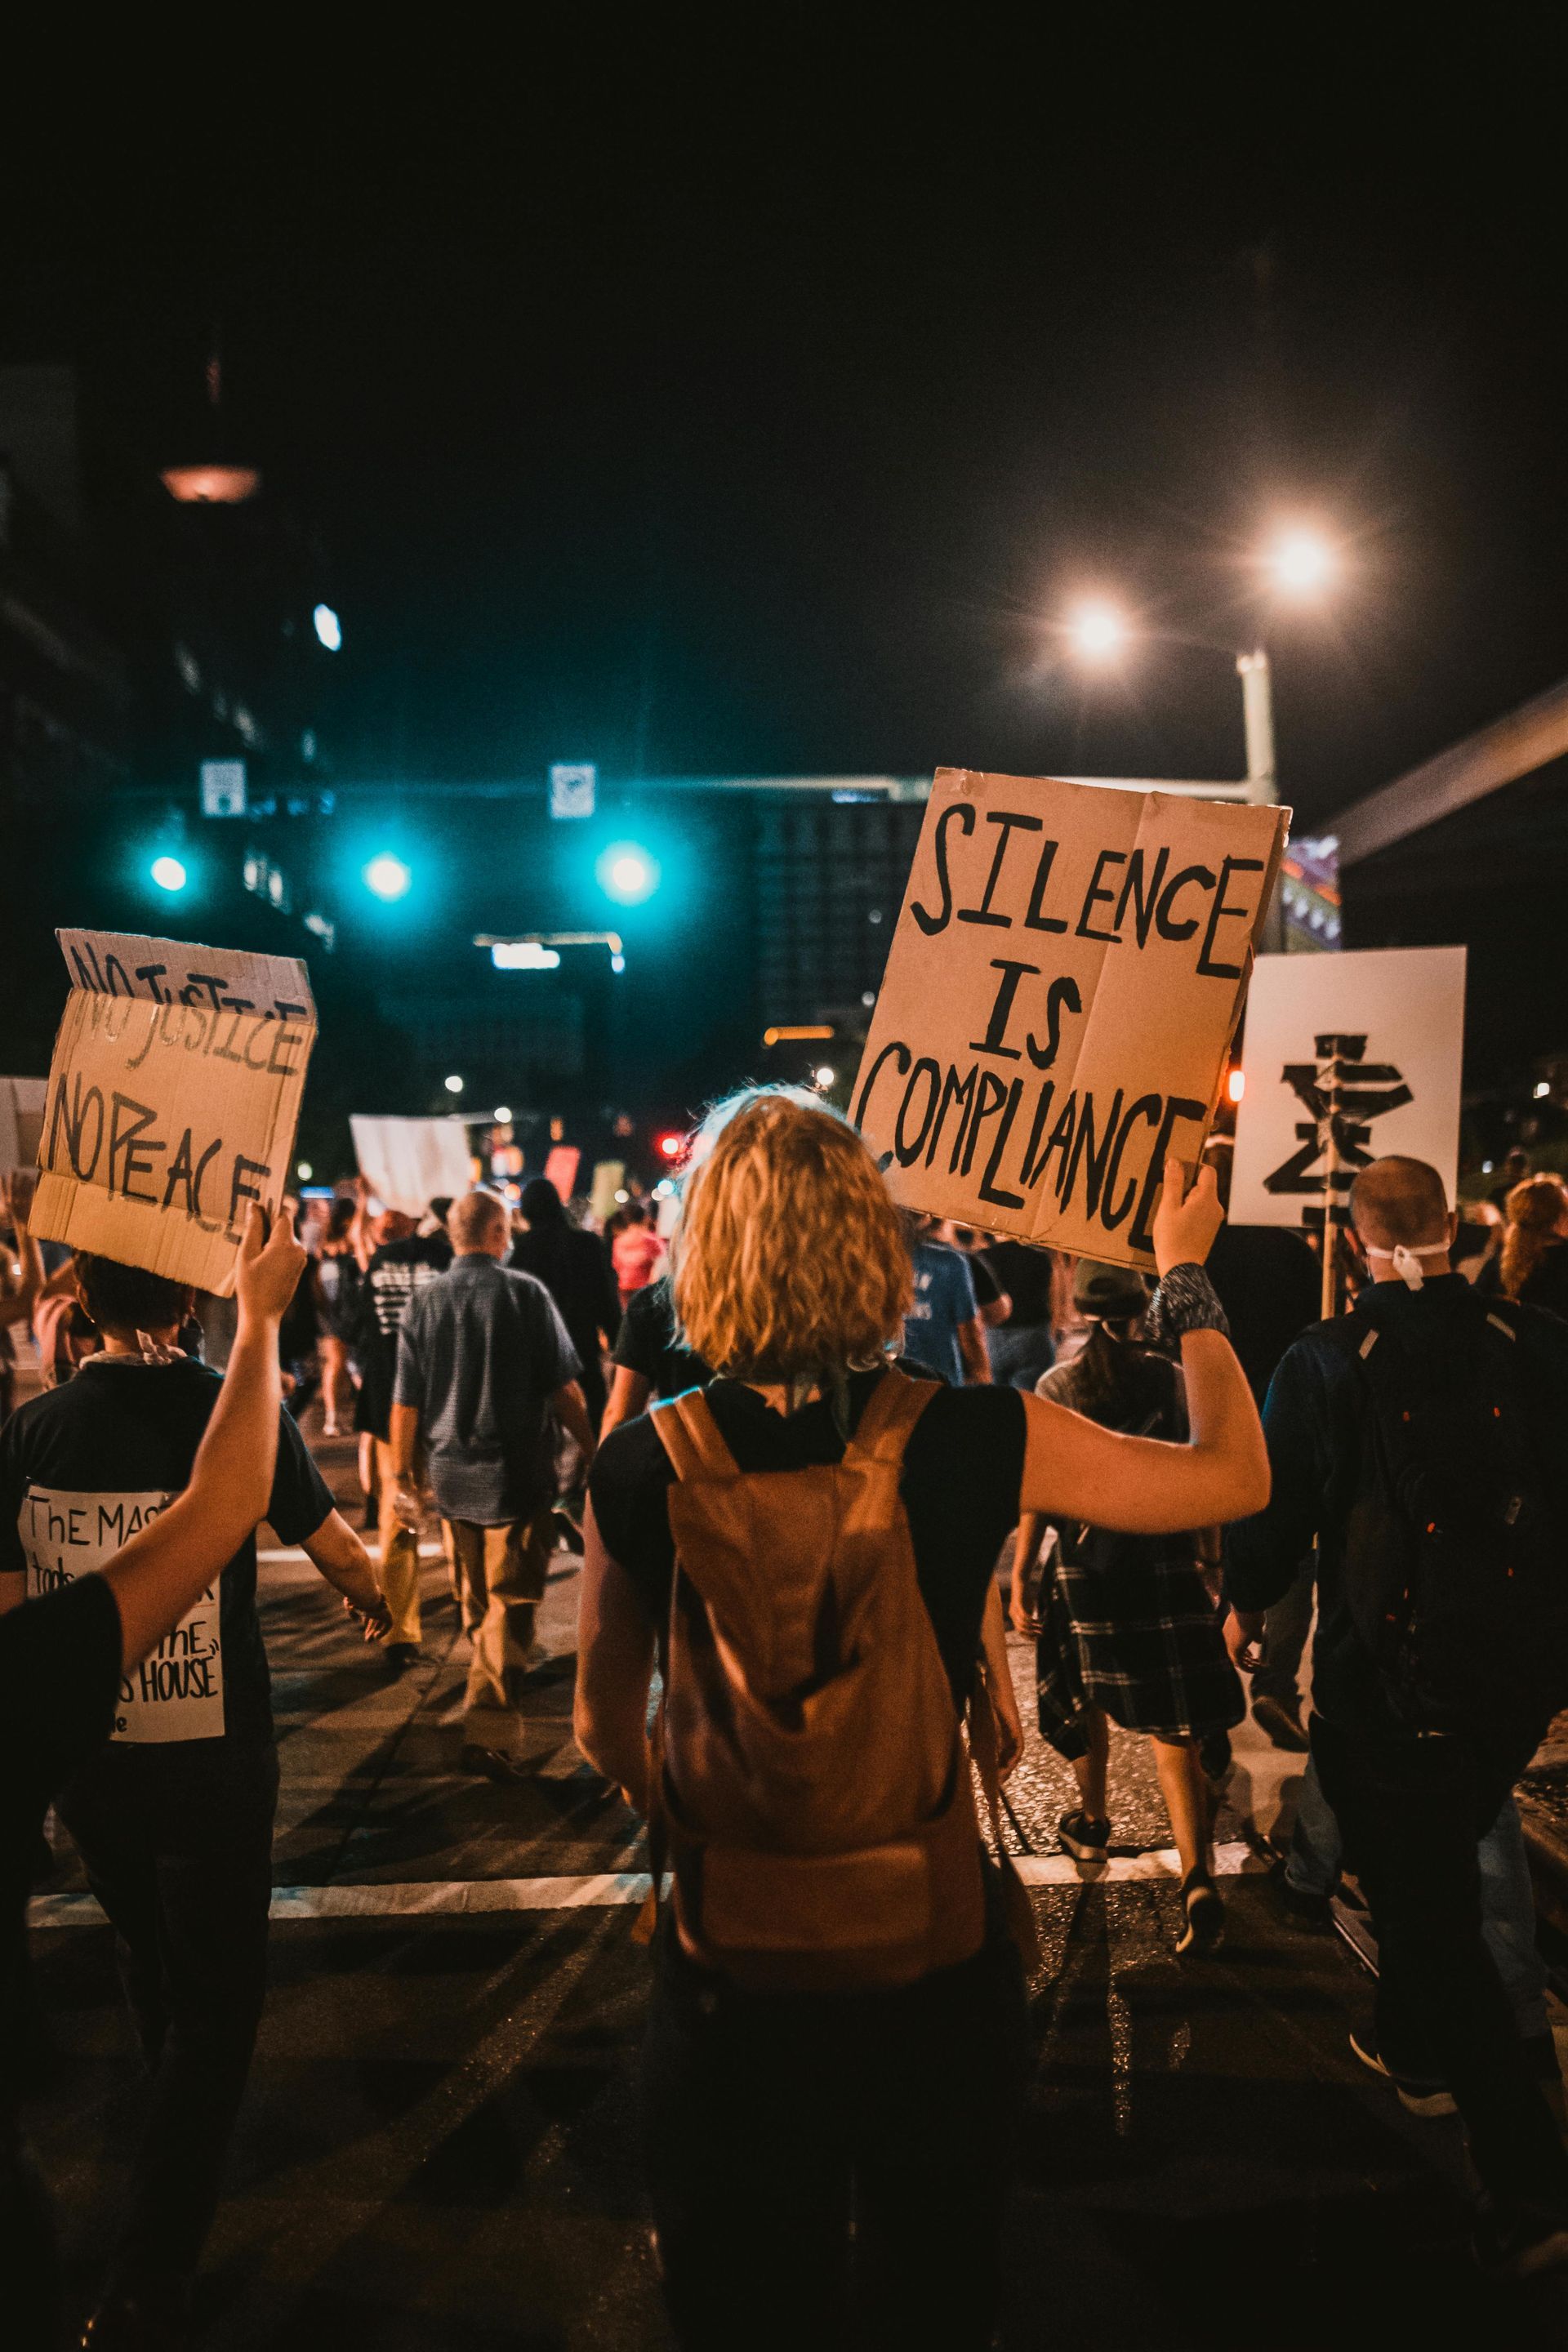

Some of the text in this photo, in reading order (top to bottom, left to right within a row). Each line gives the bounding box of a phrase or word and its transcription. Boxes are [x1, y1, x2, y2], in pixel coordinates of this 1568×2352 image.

[910, 803, 1263, 979] SILENCE
[70, 942, 307, 1076] NO JUSTICE
[969, 959, 1082, 1070] IS
[48, 1071, 272, 1242] NO PEACE
[854, 1042, 1207, 1253] COMPLIANCE
[98, 1503, 160, 1548] MAS
